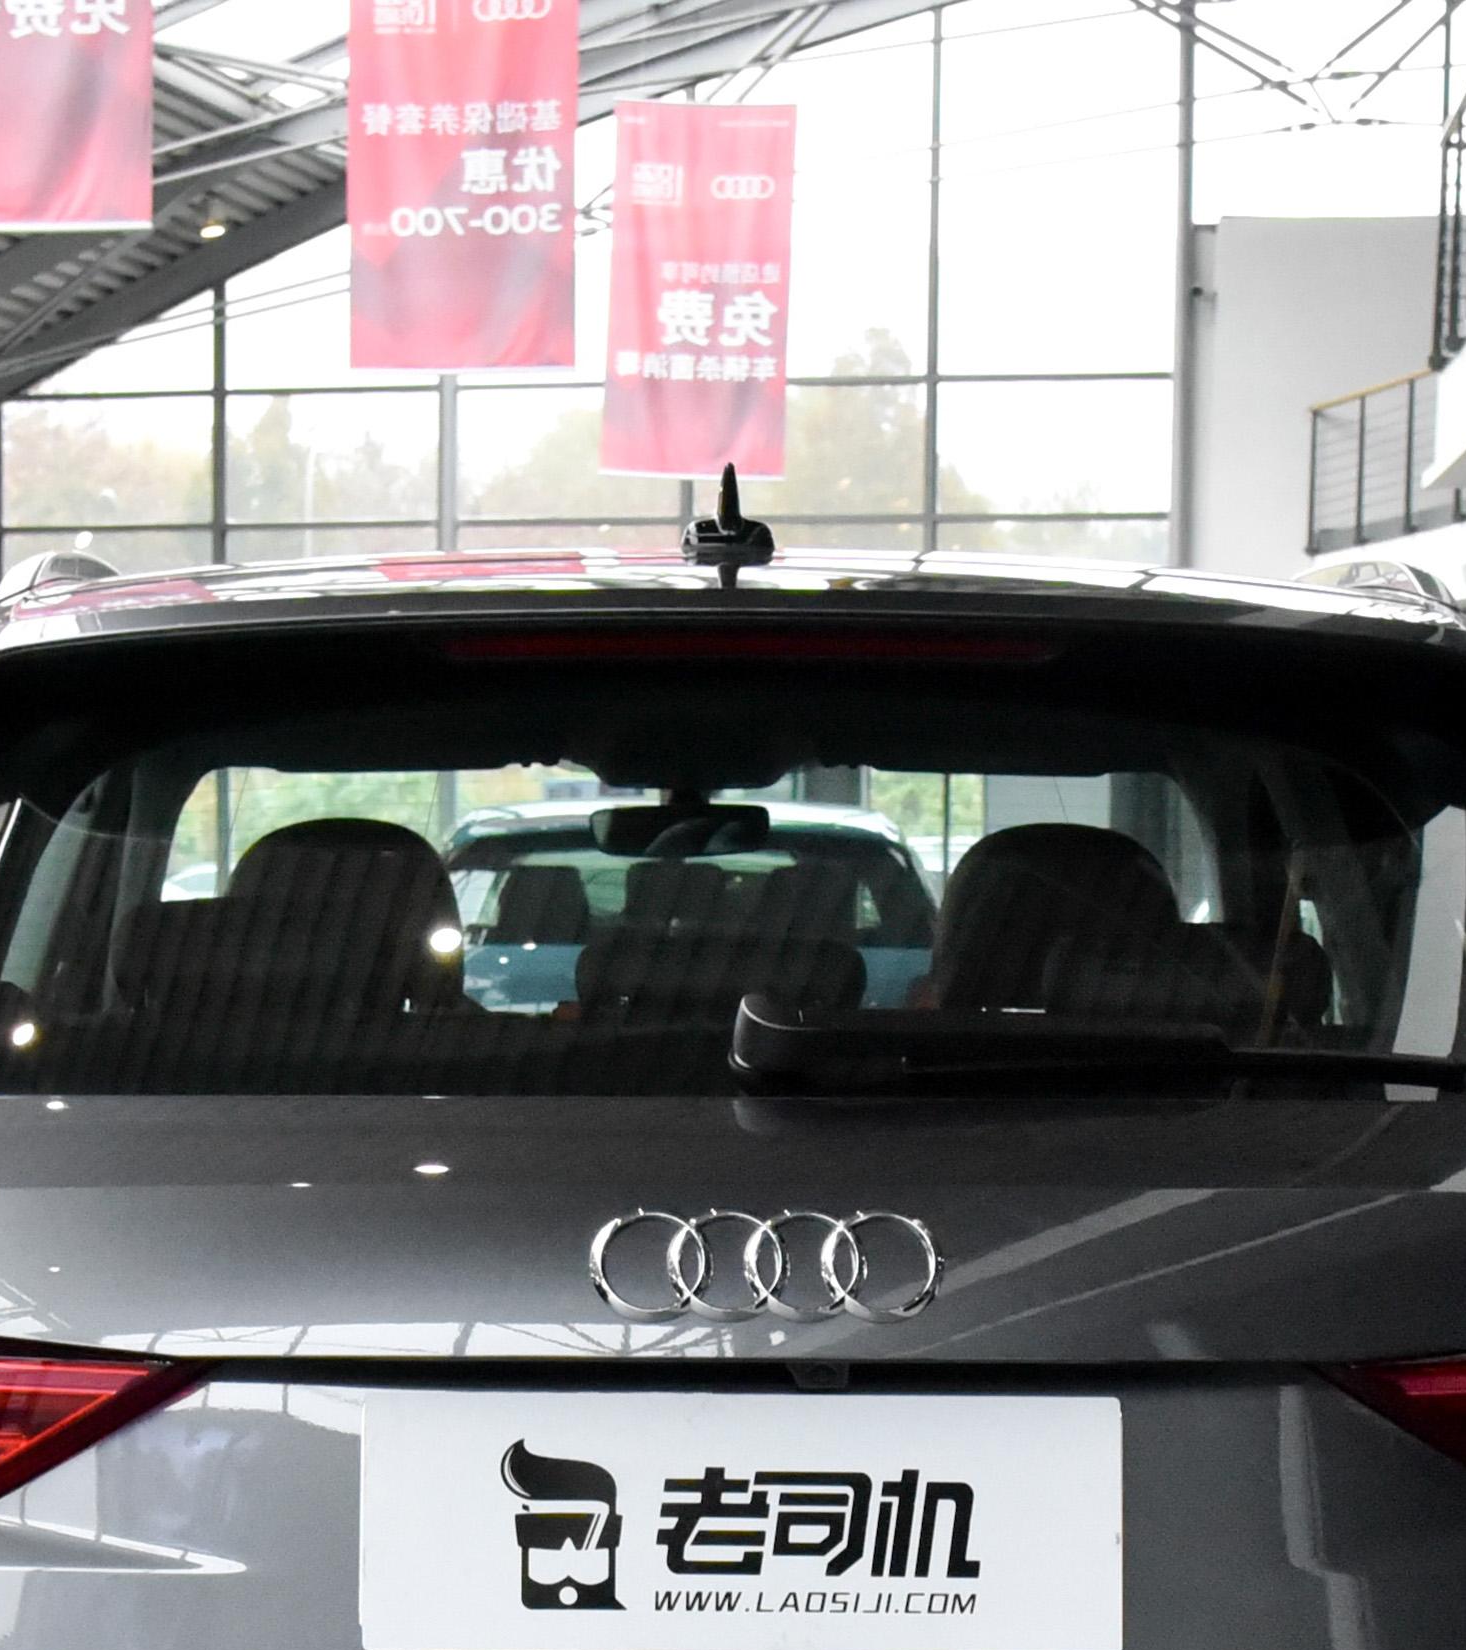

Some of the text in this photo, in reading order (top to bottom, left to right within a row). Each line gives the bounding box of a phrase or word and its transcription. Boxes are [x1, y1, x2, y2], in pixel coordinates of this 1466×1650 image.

[656, 1466, 981, 1579] 老司机
[654, 1589, 978, 1616] WWW.LAOSIJI.COM
